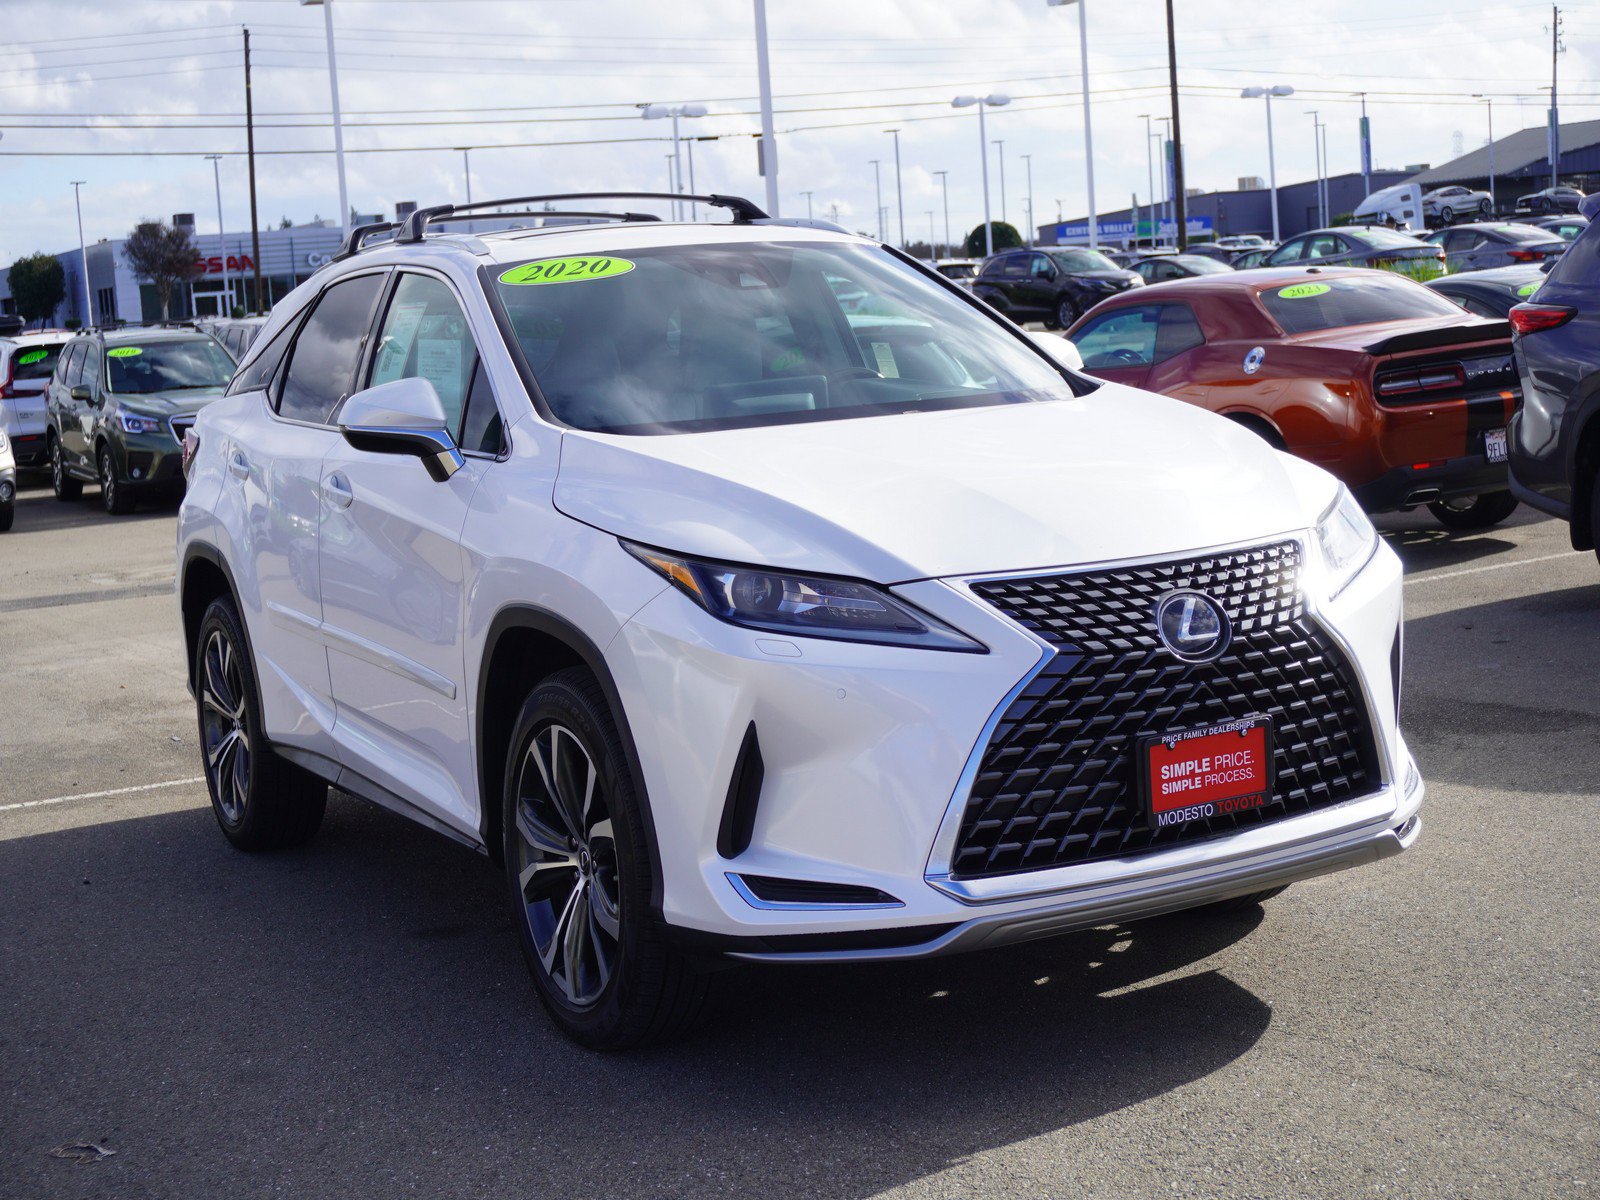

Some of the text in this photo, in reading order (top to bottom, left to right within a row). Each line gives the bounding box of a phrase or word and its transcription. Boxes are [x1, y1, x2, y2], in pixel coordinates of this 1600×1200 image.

[1066, 223, 1134, 236] CENTL VALLEY
[519, 259, 612, 282] 2020
[1468, 367, 1511, 376] DODGE
[1161, 720, 1255, 744] PRICE FAMILY DEALERSHIPS
[1161, 750, 1255, 780] SIMPLE PRICE.
[1161, 767, 1255, 795] SIMPLE PROCESS.
[1158, 795, 1264, 827] MODESTO TOYOTA
